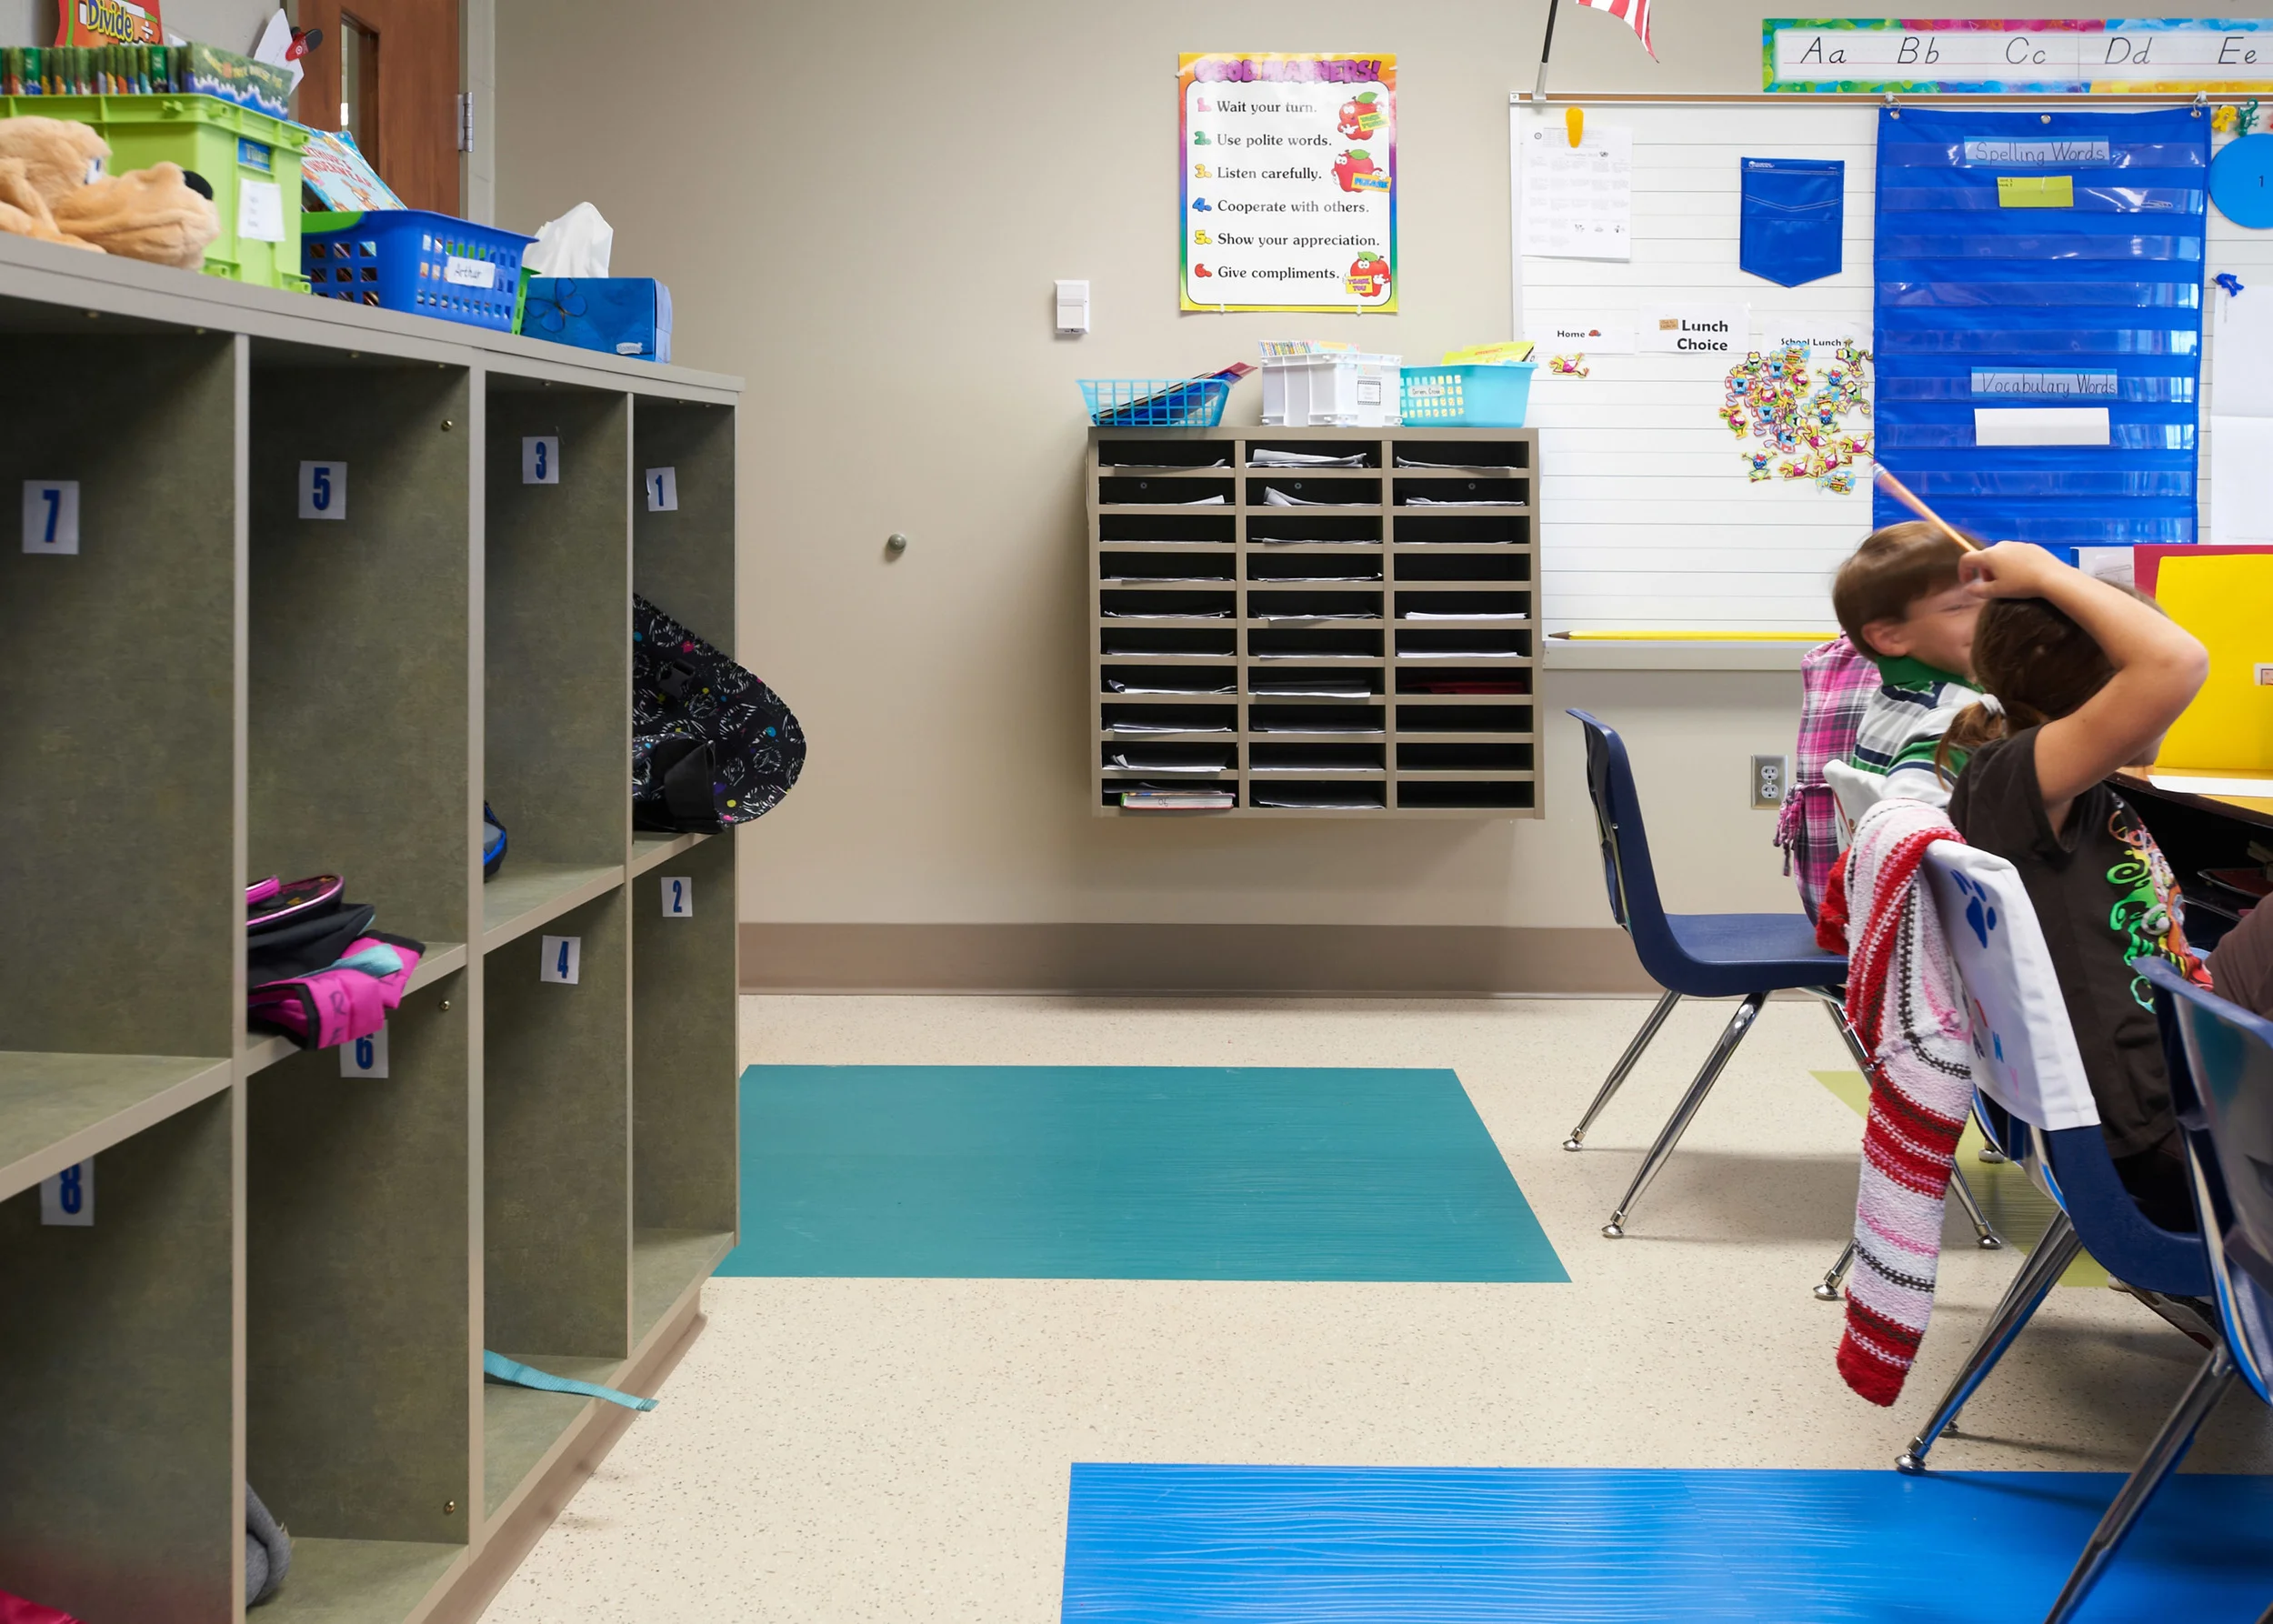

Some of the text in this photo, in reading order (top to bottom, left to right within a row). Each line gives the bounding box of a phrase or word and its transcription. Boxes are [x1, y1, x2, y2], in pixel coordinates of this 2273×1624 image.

[87, 0, 134, 42] Divide
[1799, 36, 2258, 65] Aa Bb Cc Dd Ee
[1217, 101, 1247, 113] Wait
[1251, 104, 1281, 115] your
[1286, 102, 1317, 113] turn.
[1217, 134, 1242, 145] Use
[1247, 134, 1284, 147] polite
[1287, 135, 1332, 146] words.
[1976, 142, 2106, 166] Spelling Words
[1217, 166, 1257, 179] Listen
[1261, 167, 1322, 181] carefully.
[2258, 175, 2264, 187] 1
[1217, 200, 1287, 215] Cooperate
[1291, 200, 1319, 213] with
[1324, 201, 1369, 214] others.
[1217, 233, 1255, 246] Show
[1258, 236, 1288, 247] your
[1293, 234, 1380, 248] appreciation.
[1217, 266, 1247, 278] Give
[1251, 266, 1340, 281] compliments.
[1557, 330, 1586, 338] Home
[1682, 319, 1728, 332] Lunch
[1677, 337, 1728, 351] Choice
[1813, 338, 1842, 346] Lunch
[1982, 373, 2117, 398] Vocabulary Words
[536, 441, 546, 480] 3
[313, 467, 331, 510] 5
[656, 475, 664, 506] 1
[43, 489, 61, 543] 7
[672, 880, 682, 913] 2
[557, 941, 569, 978] 4
[355, 1033, 374, 1070] 6
[59, 1163, 82, 1215] 8
